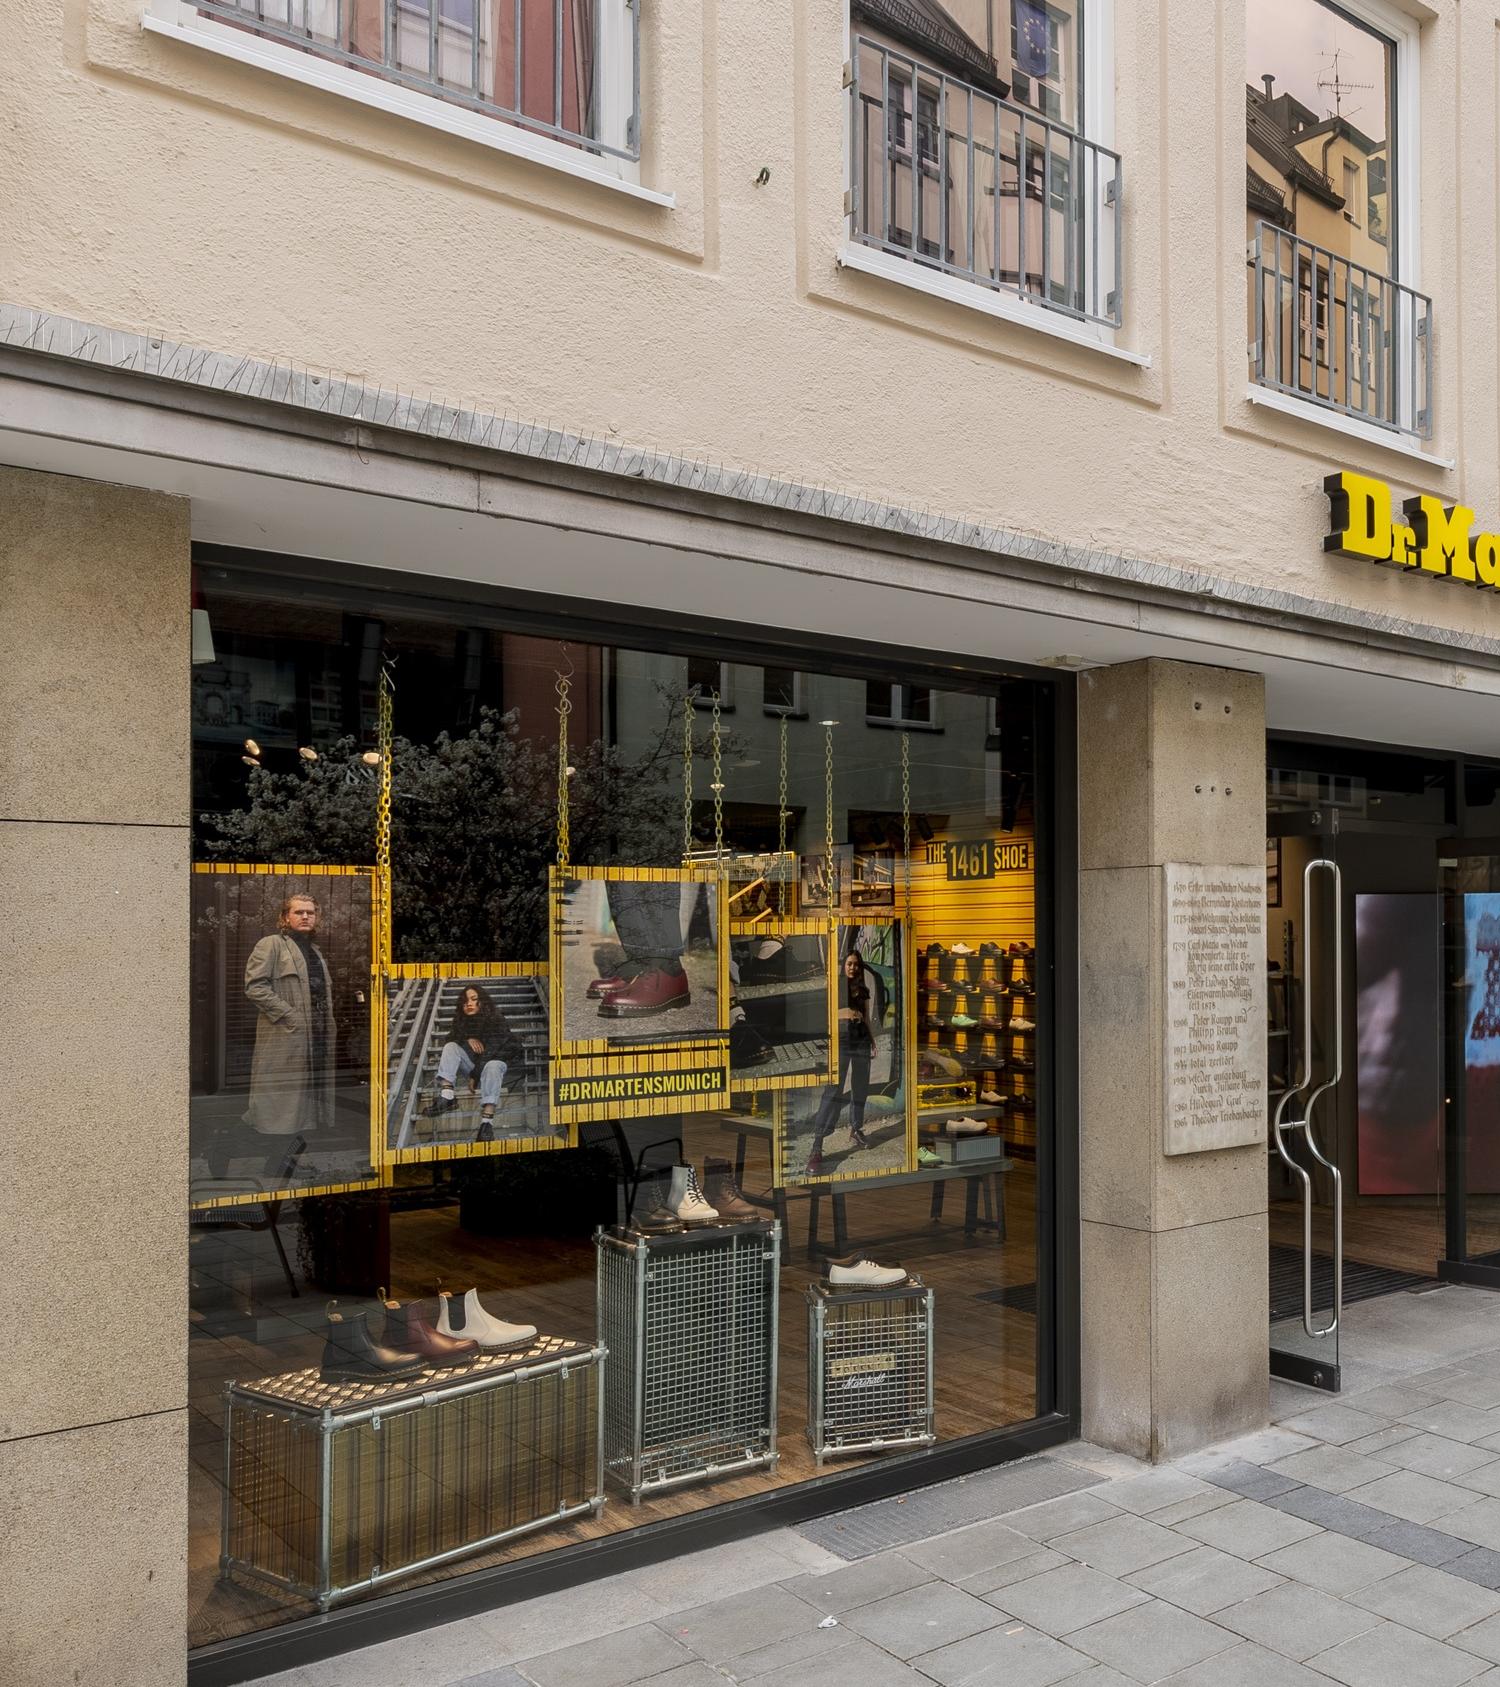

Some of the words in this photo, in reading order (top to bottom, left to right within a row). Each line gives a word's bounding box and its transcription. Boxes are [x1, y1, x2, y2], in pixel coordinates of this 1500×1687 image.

[927, 842, 947, 864] THE
[949, 842, 988, 877] 1461
[994, 845, 1026, 870] SHOE
[560, 1072, 721, 1102] #DRMARTENSMUNICH
[841, 1372, 886, 1389] Marshall
